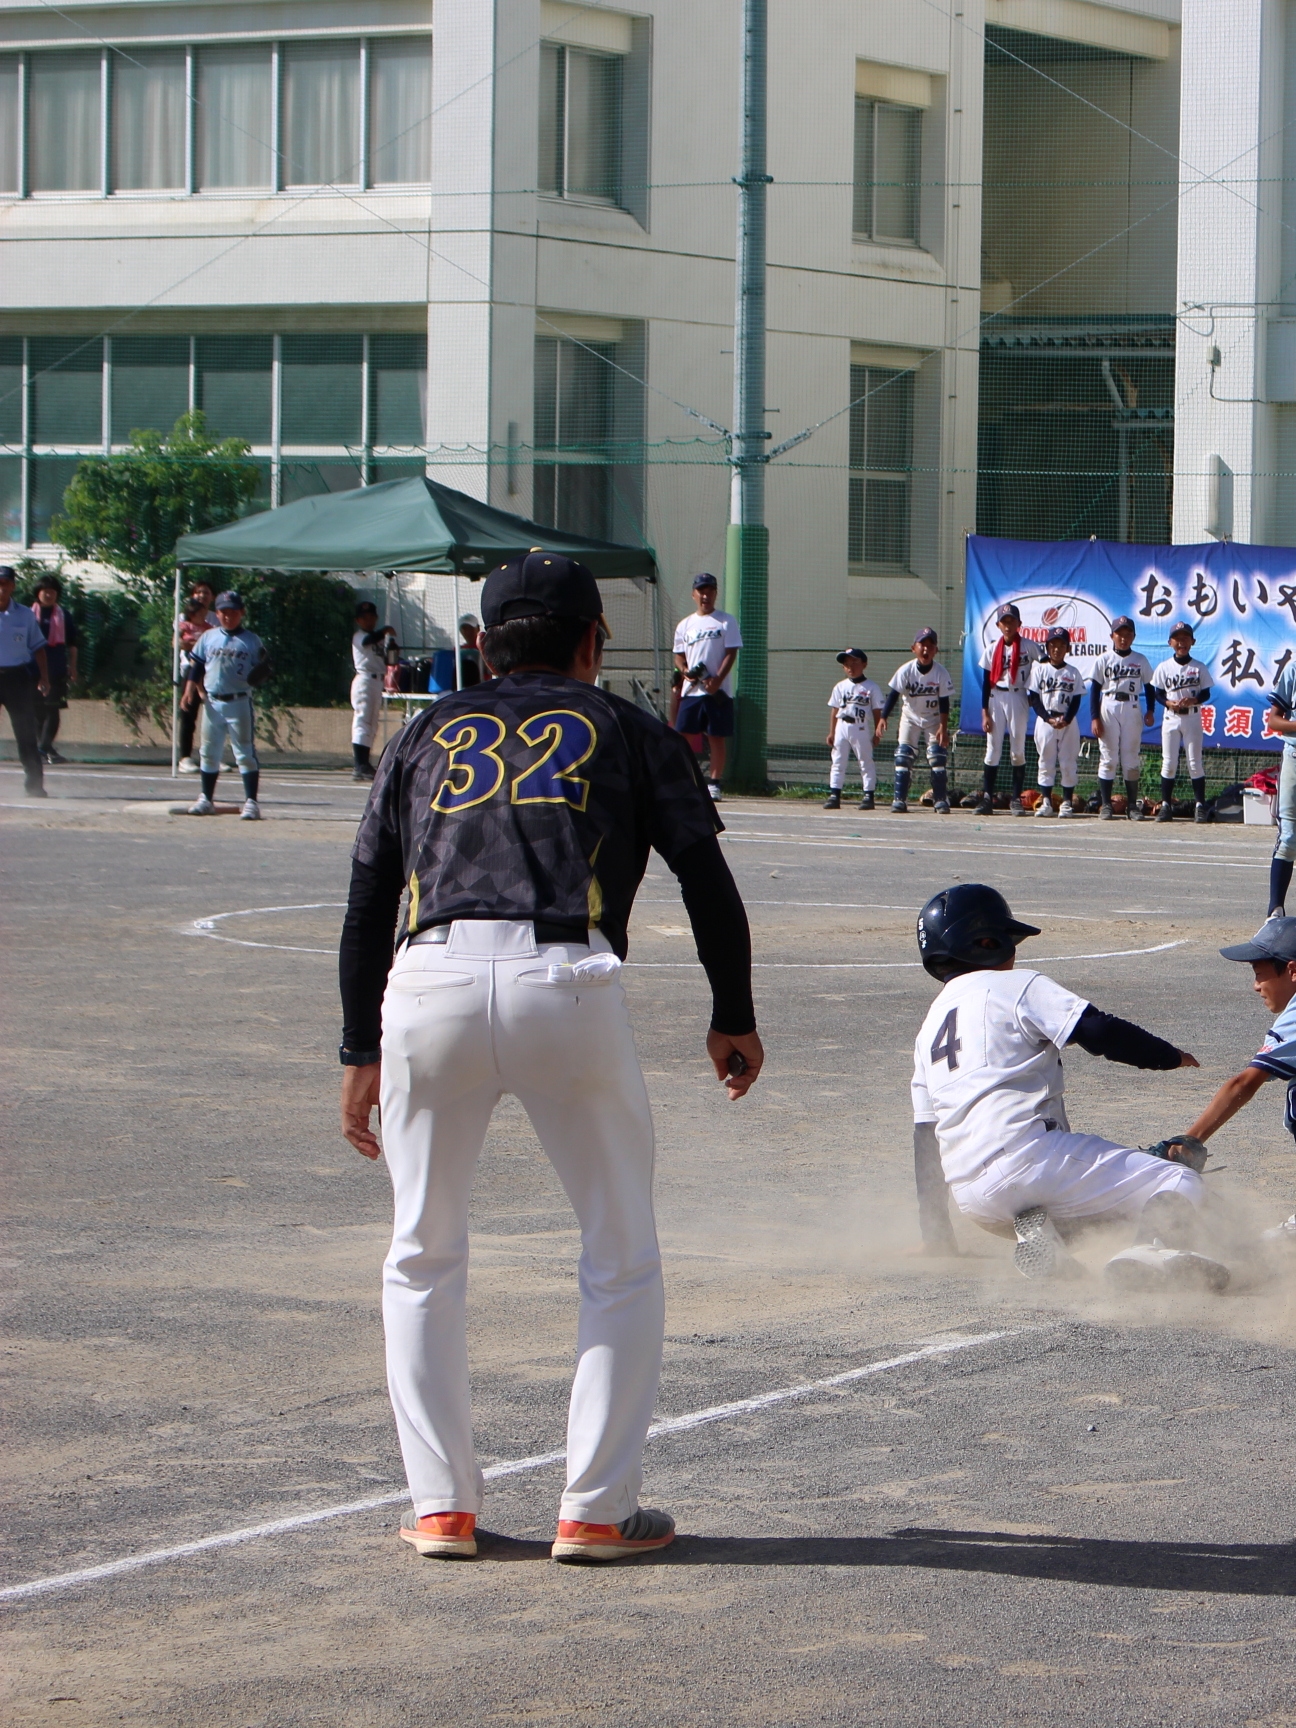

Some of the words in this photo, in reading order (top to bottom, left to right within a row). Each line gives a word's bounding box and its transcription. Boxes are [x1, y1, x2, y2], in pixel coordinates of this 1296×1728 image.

[1104, 664, 1141, 680] Wins
[1039, 677, 1075, 693] Wins
[1128, 681, 1136, 692] 5
[1165, 674, 1200, 691] Wins
[430, 709, 598, 814] 32
[931, 1005, 962, 1073] 4
